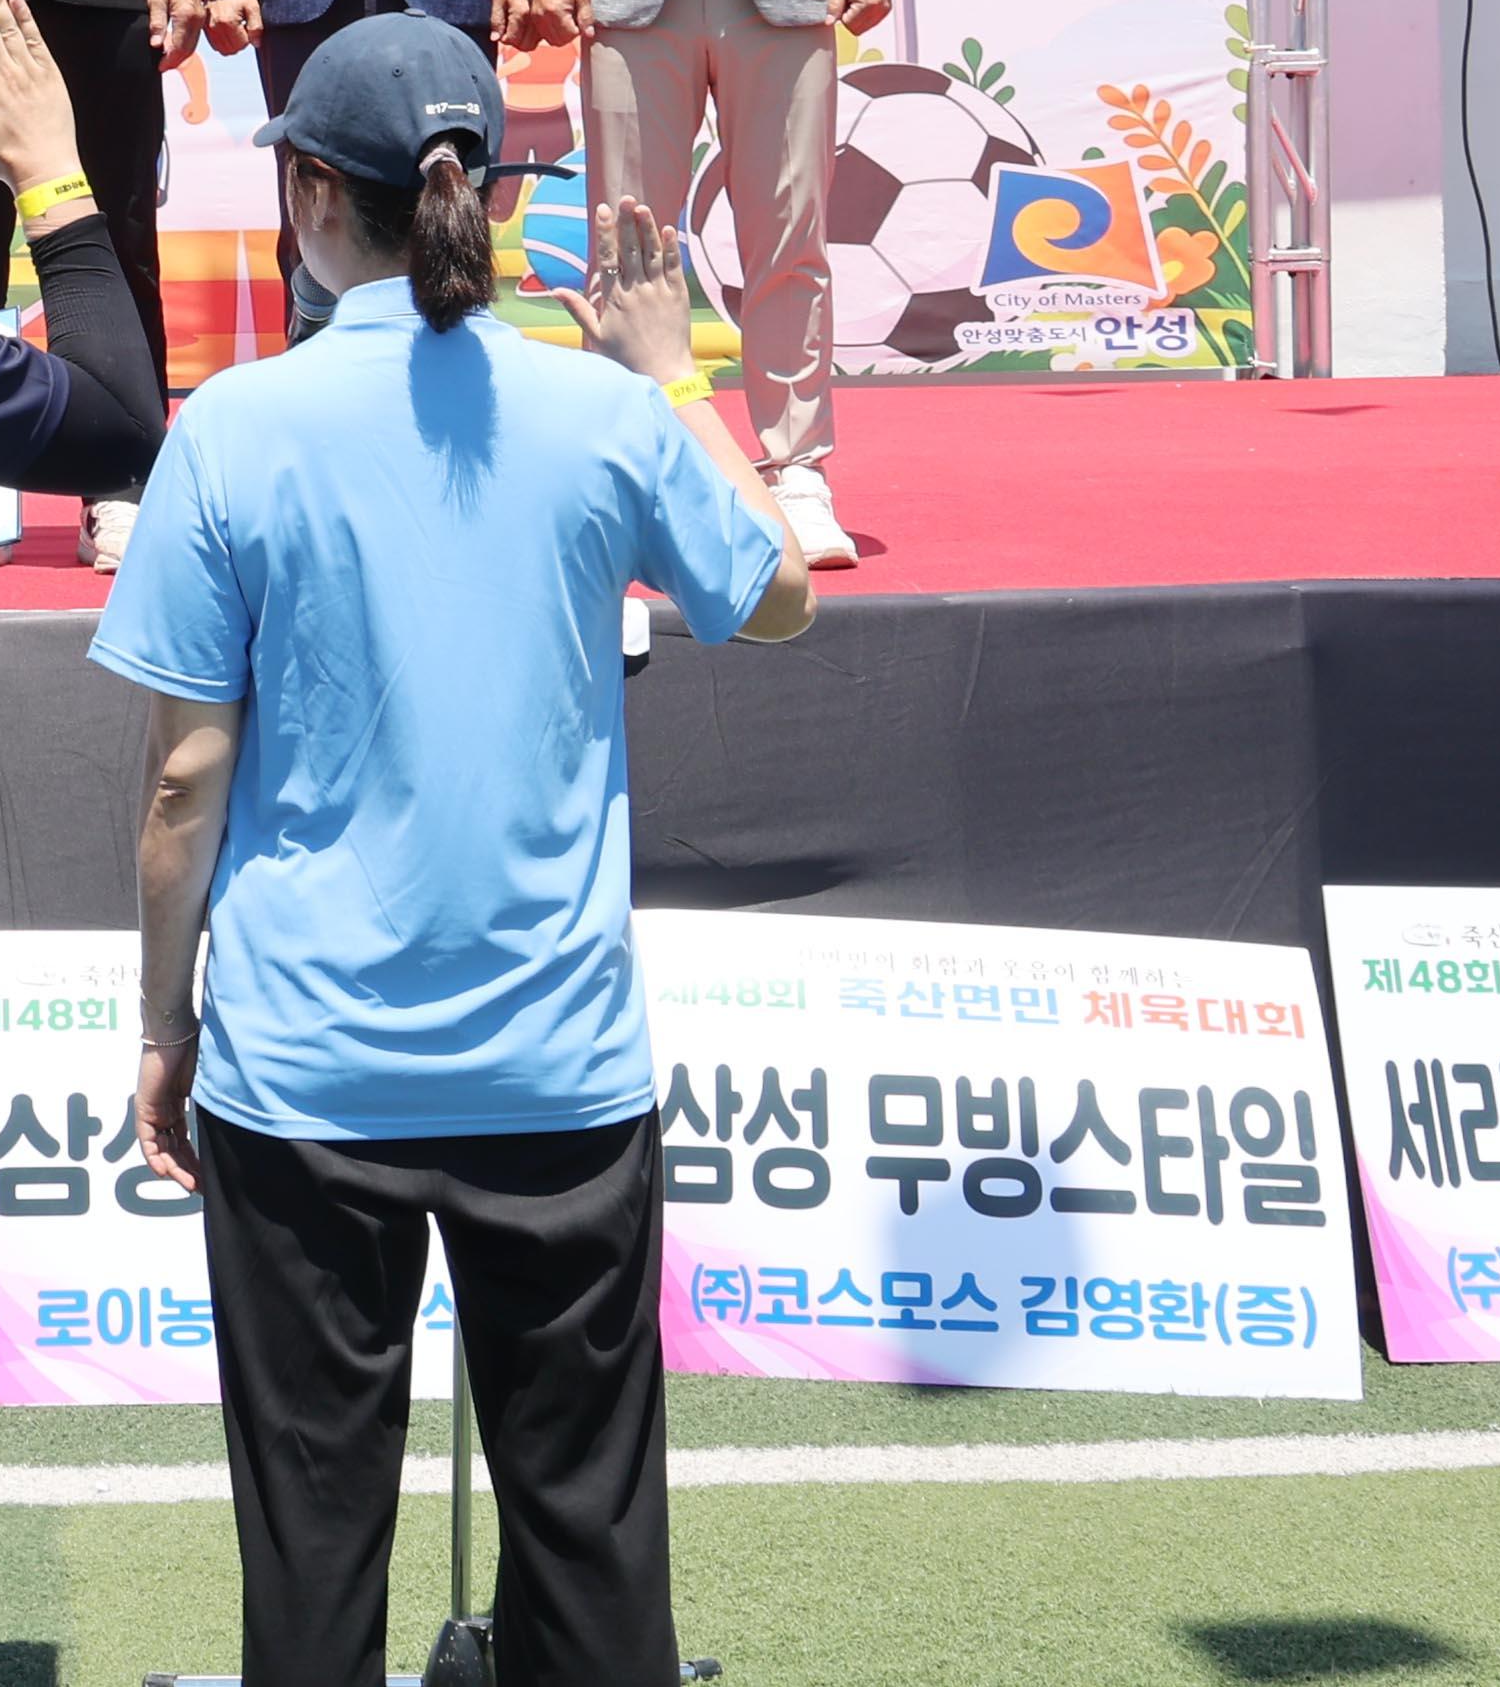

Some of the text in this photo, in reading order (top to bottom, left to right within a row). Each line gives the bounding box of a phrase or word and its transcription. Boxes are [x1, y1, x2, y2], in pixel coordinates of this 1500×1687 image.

[961, 314, 1189, 352] 안성맞춤도시 안성
[993, 290, 1142, 311] City of Masters
[838, 975, 1062, 1026] 죽산면민
[1083, 988, 1306, 1040] 체육대회
[660, 1062, 1328, 1229] 삼성 무빙스타일
[1020, 1272, 1319, 1350] 김영환(증)
